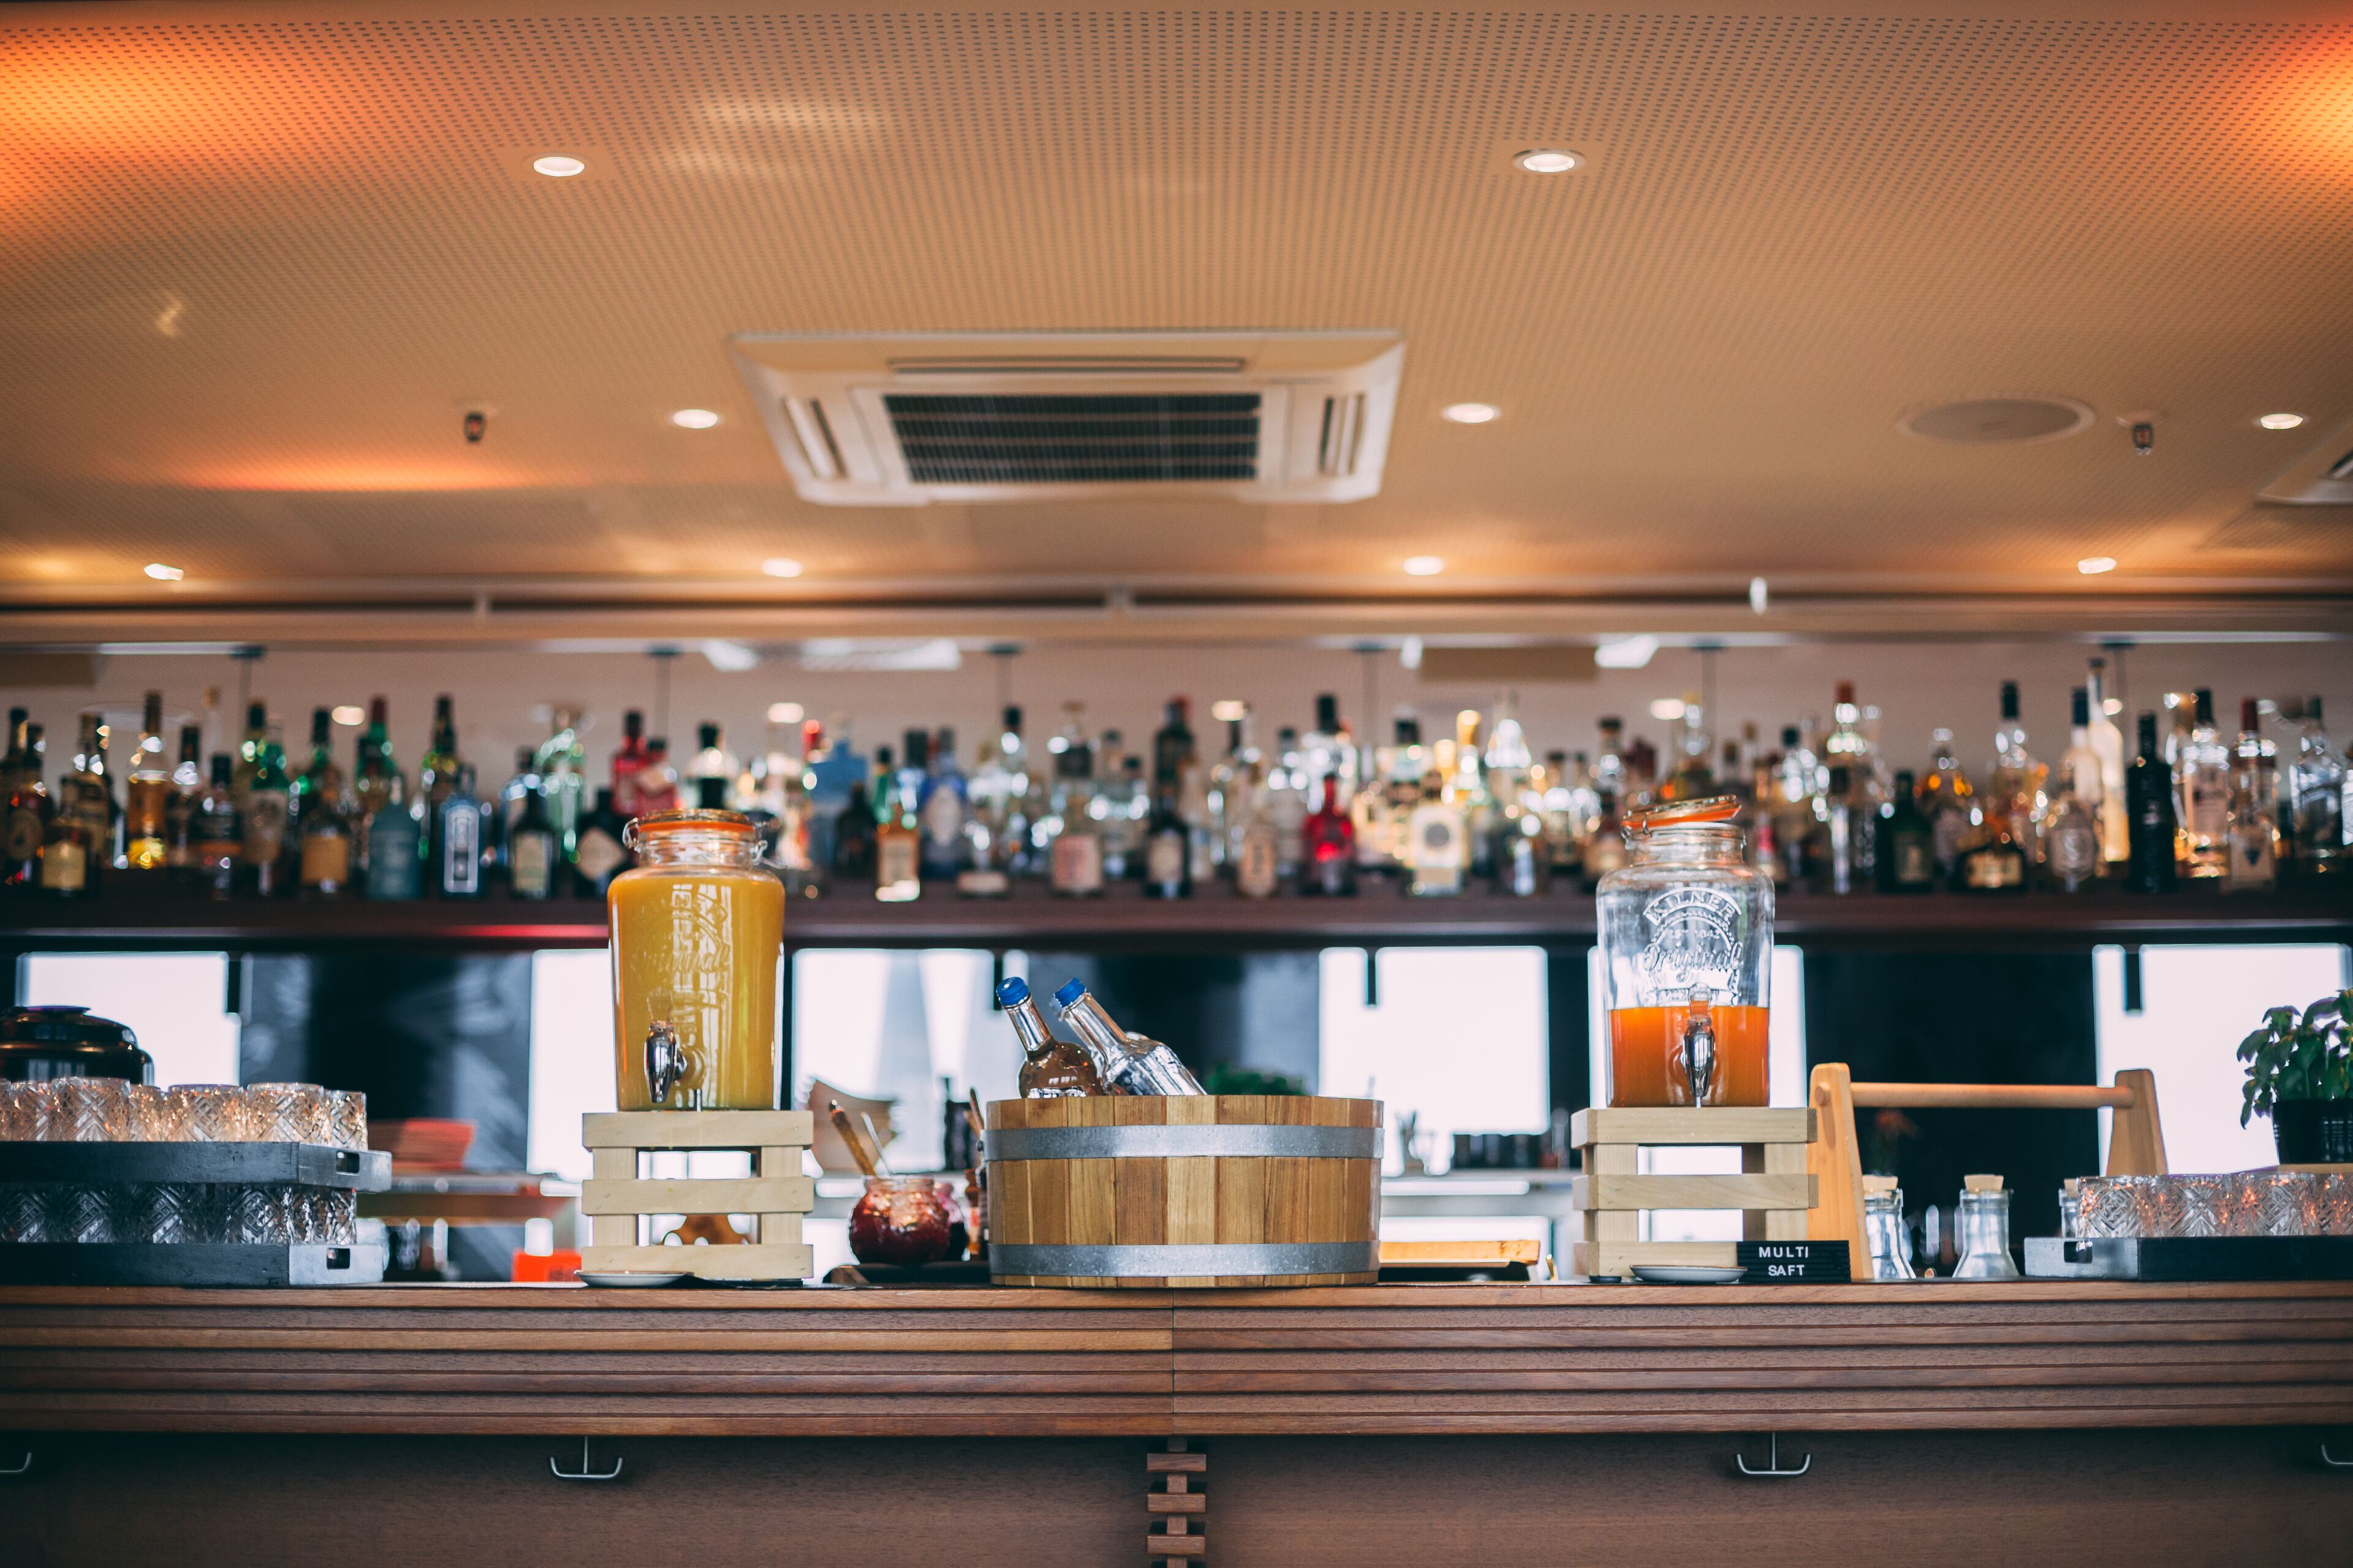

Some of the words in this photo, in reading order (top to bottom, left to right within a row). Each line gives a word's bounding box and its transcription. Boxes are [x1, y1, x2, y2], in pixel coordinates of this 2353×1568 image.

[1647, 890, 1736, 924] KILNER
[1643, 941, 1744, 983] Original
[1758, 1246, 1809, 1259] MULTI
[1768, 1264, 1805, 1276] SAFT
